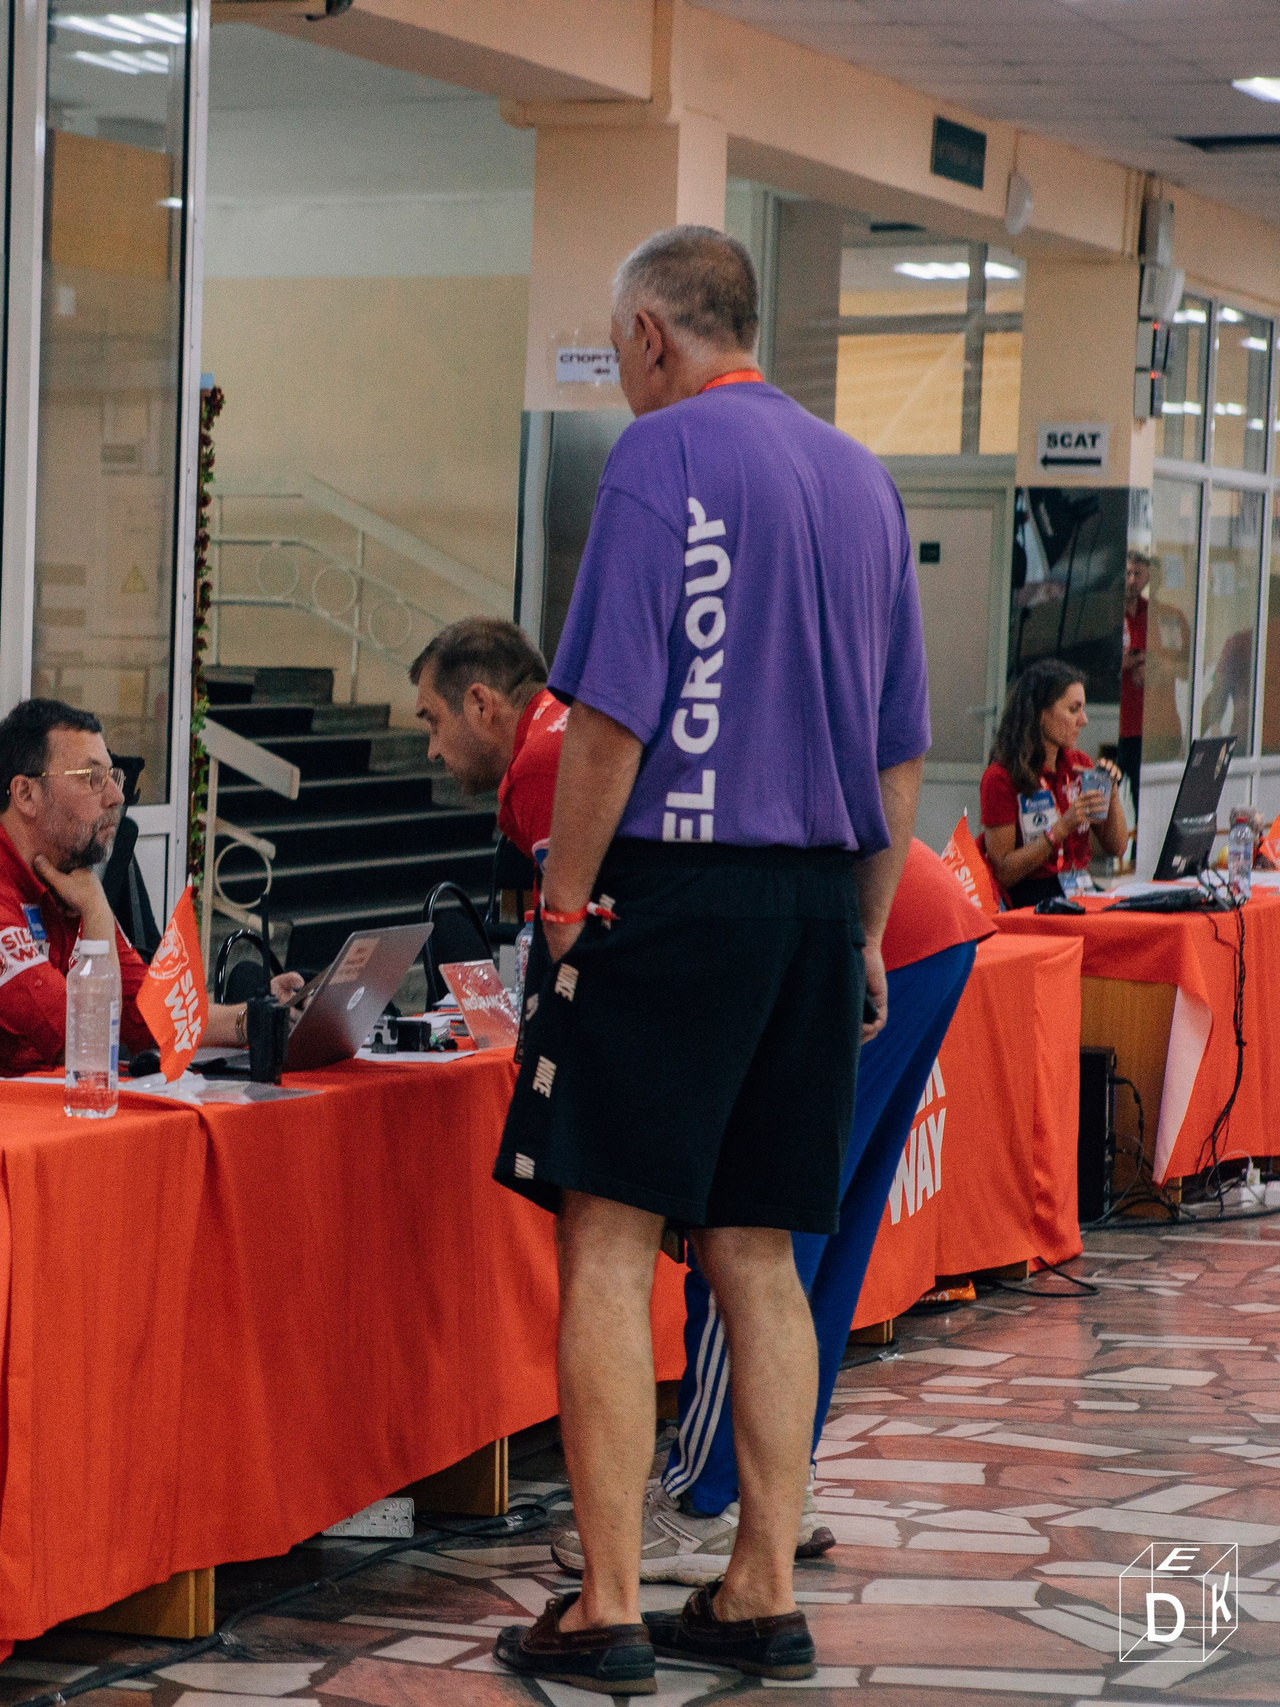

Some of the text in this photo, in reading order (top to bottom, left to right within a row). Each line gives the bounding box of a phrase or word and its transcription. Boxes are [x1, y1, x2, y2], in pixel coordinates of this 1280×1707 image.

[1046, 431, 1101, 449] SCAT
[671, 496, 733, 756] GROUP
[1, 929, 32, 951] SIL
[164, 980, 193, 1053] WAY
[180, 968, 202, 1047] SILK
[532, 1054, 558, 1099] NIKE
[888, 1107, 947, 1226] WAY
